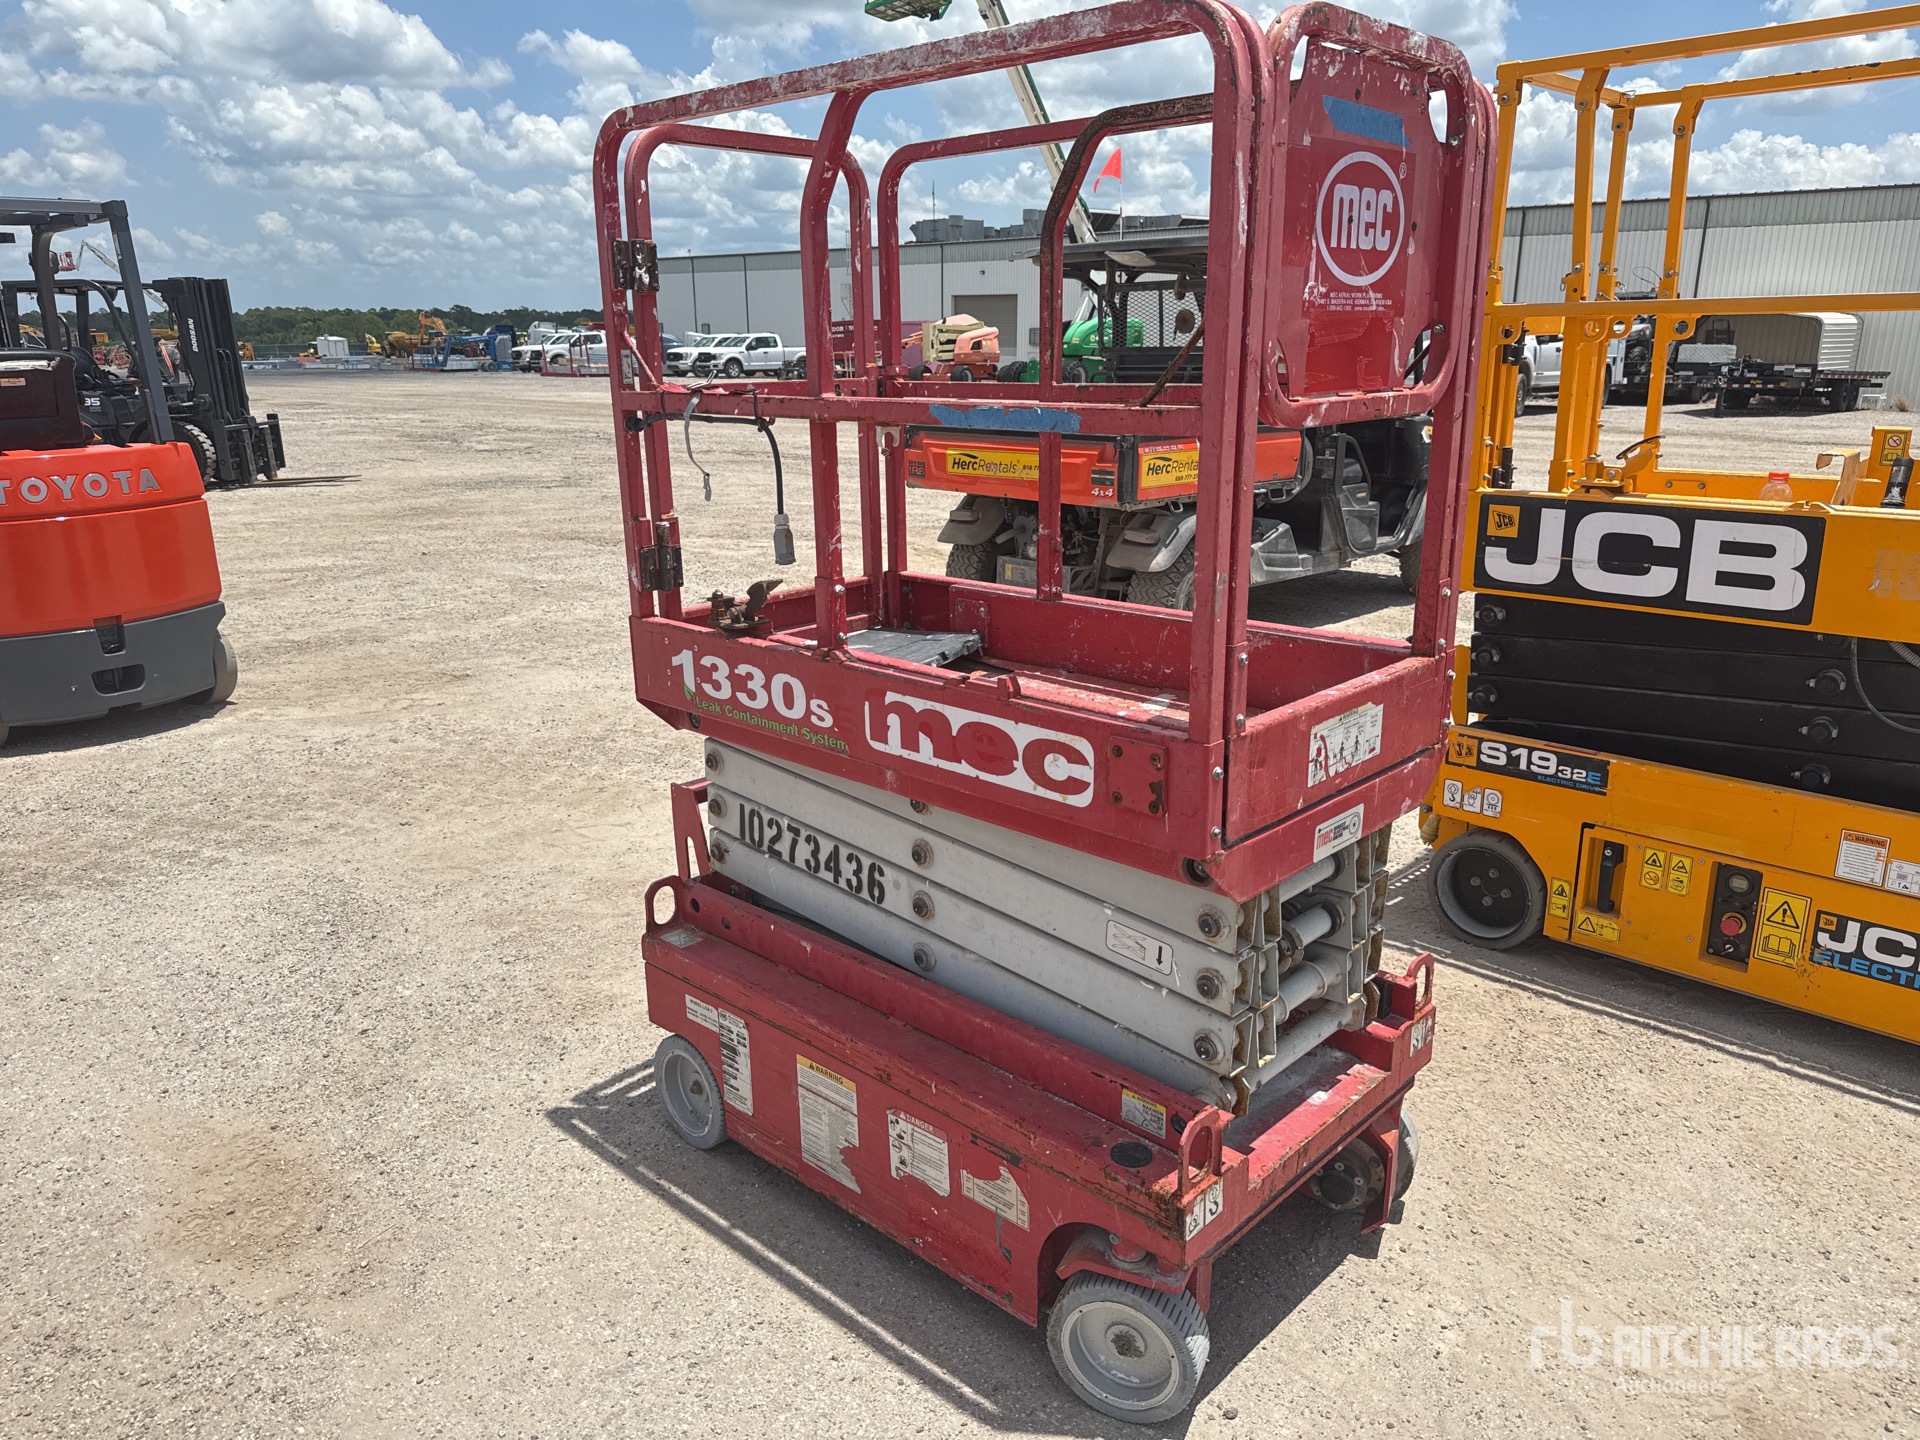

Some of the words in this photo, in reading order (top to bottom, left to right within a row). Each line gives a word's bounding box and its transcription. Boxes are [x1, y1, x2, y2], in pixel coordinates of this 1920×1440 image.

[1330, 183, 1394, 252] mec
[187, 317, 199, 353] DOOSAN
[84, 397, 101, 406] 35
[951, 456, 1018, 475] HercRentals
[1090, 486, 1114, 498] 4x4
[1495, 511, 1514, 529] JCB
[1483, 507, 1809, 612] JCB
[695, 696, 722, 714] Leak
[725, 704, 799, 737] Containment
[802, 727, 849, 751] System
[867, 690, 1093, 797] mec
[1537, 775, 1574, 788] ELECTRIC
[1854, 835, 1886, 848] WARNING
[738, 802, 887, 905] 10273436
[1817, 920, 1920, 973] JC
[814, 1064, 844, 1085] WARNING
[906, 1114, 934, 1133] DANGER
